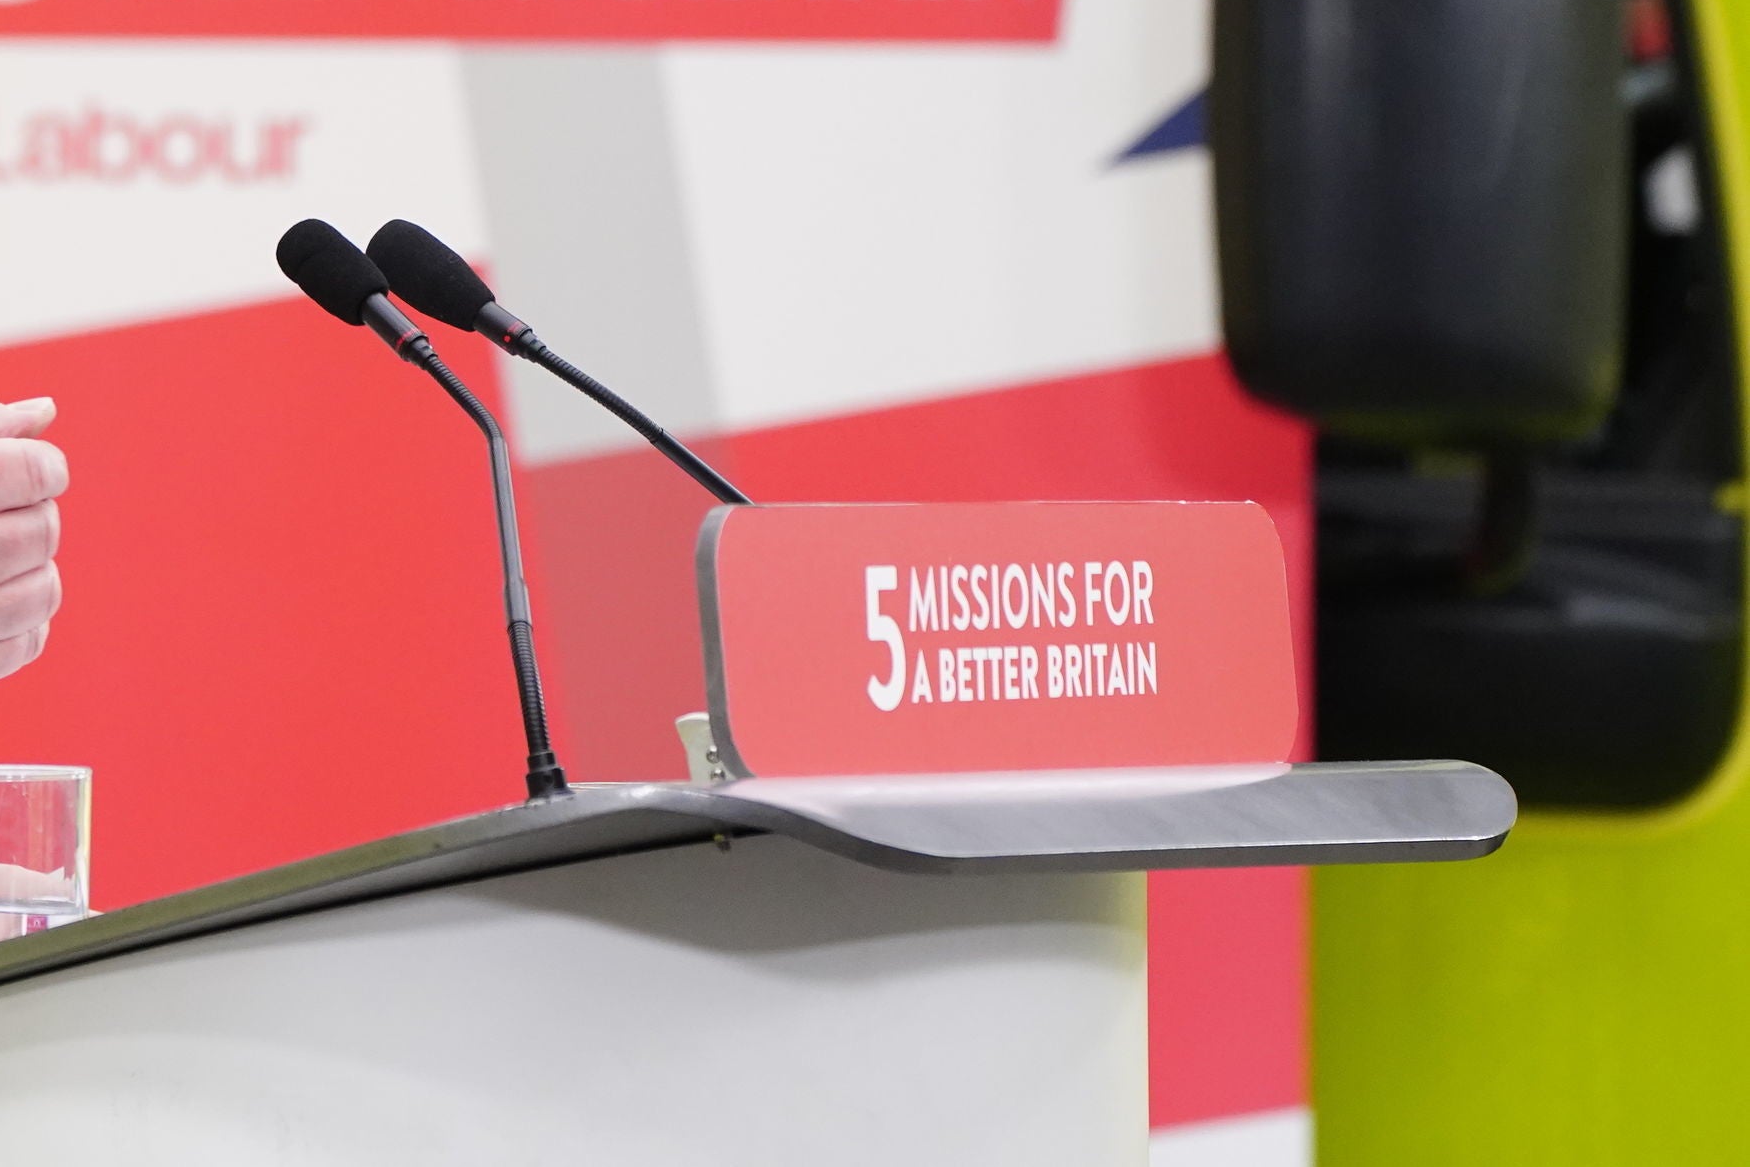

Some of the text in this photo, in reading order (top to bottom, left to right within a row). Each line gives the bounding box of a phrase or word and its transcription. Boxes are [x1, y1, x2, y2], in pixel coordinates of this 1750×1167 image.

[864, 560, 1154, 712] 5 MISSIONS FOR
[911, 641, 1158, 704] A BETTER BRITAIN
